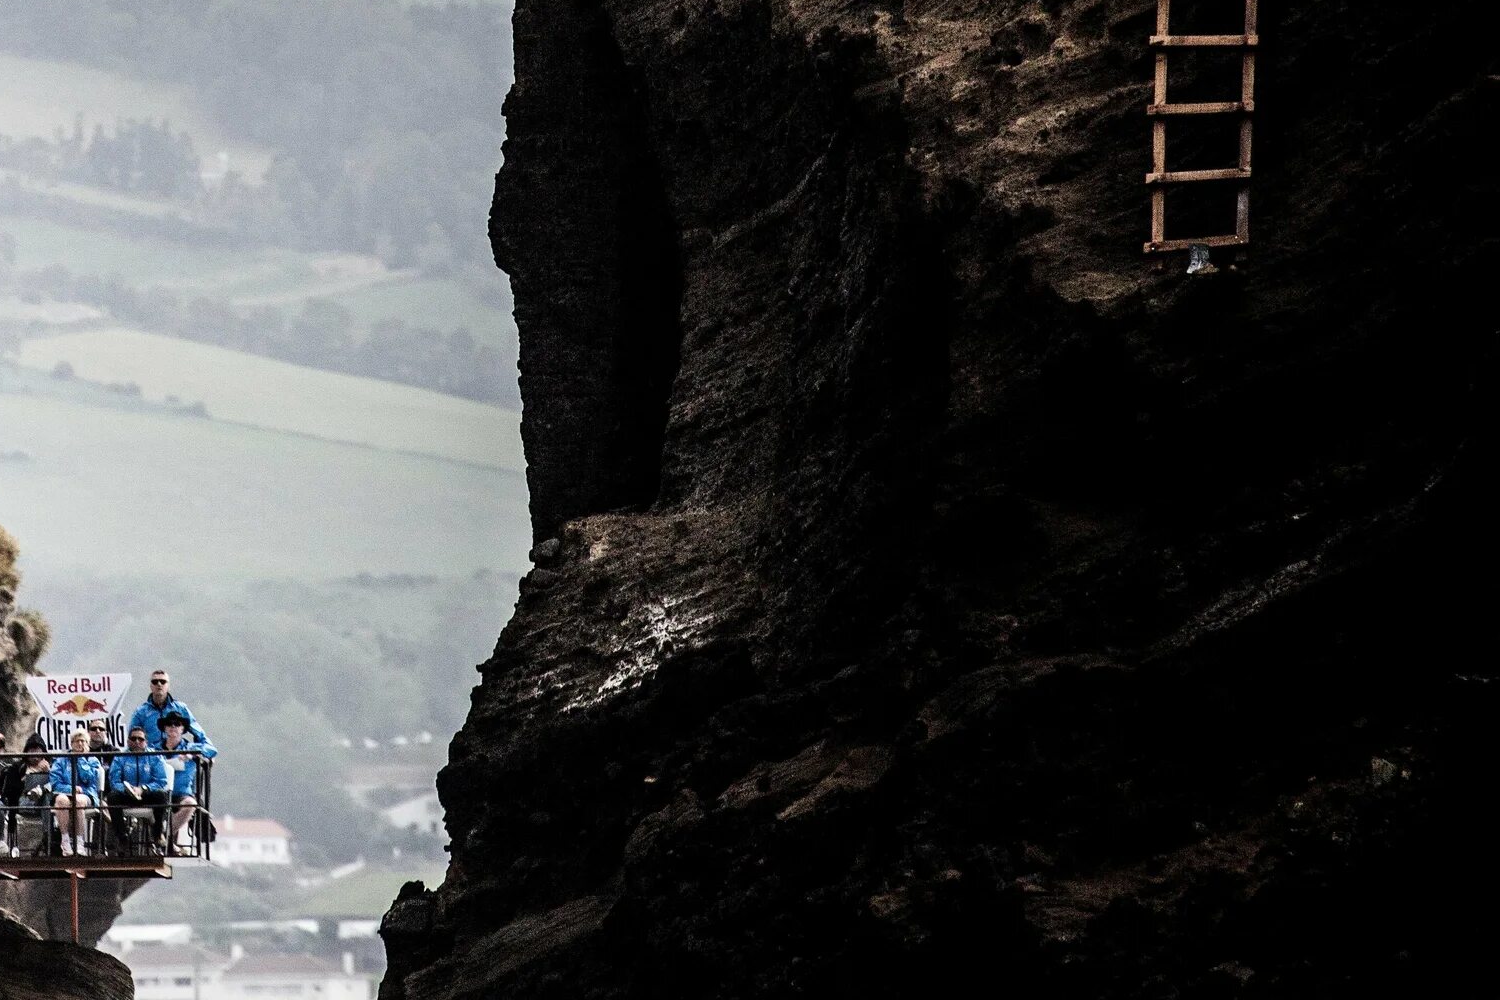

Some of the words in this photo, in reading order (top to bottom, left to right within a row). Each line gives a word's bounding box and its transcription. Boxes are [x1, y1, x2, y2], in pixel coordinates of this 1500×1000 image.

[47, 678, 78, 694] Red
[81, 676, 111, 693] Bull
[37, 716, 71, 751] CLIFF
